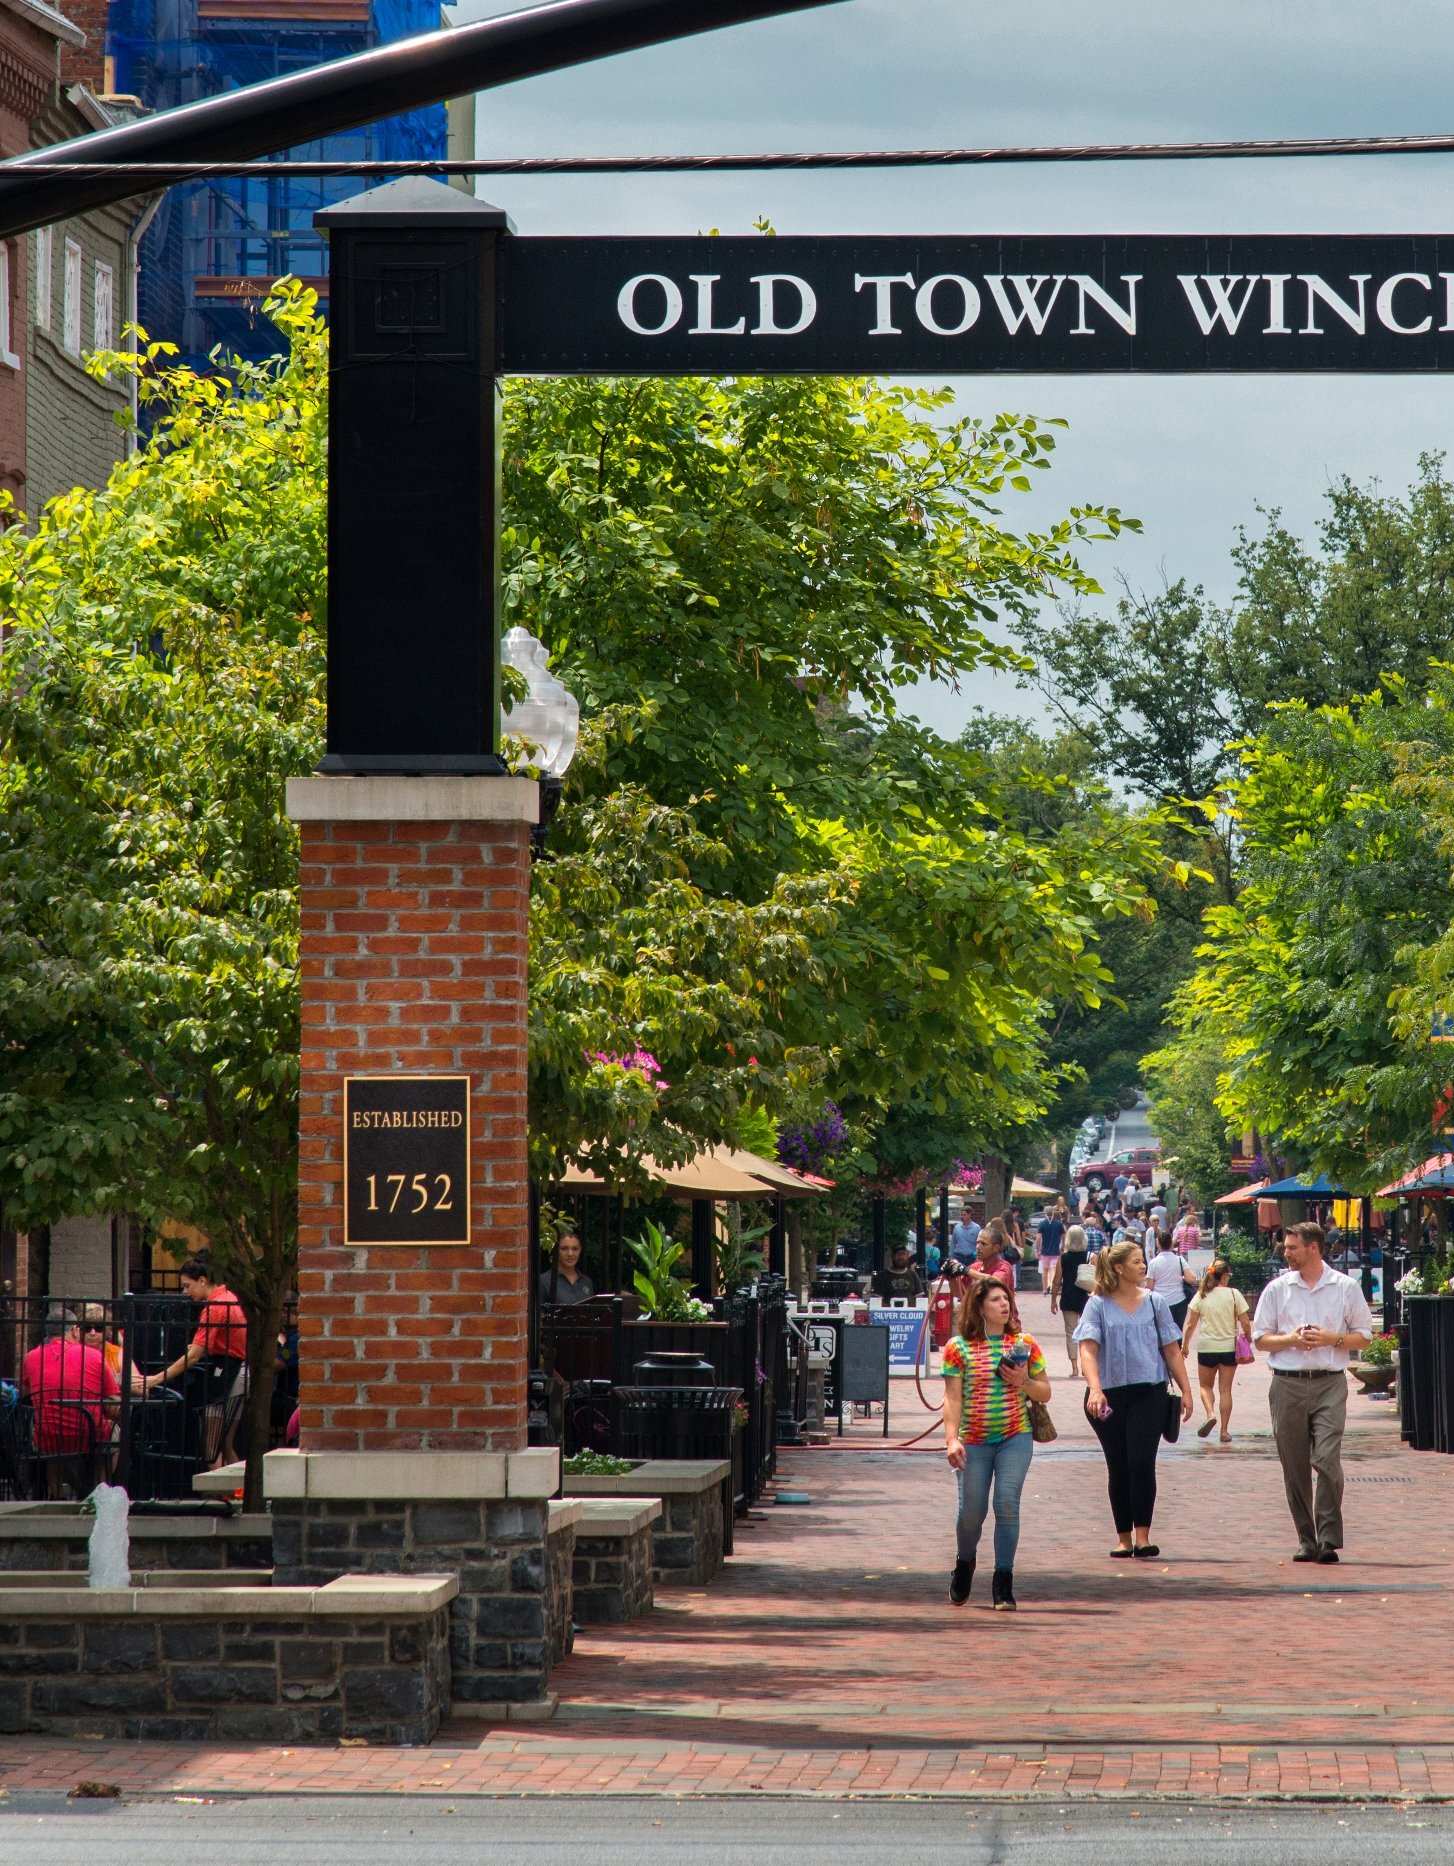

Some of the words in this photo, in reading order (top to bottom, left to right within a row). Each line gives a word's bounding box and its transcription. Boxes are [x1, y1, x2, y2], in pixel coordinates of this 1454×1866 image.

[617, 274, 817, 336] OLD
[854, 271, 1143, 337] TOWN
[352, 1111, 463, 1129] ESTABLISHED
[366, 1173, 453, 1213] 1752
[873, 1312, 898, 1320] SILVER
[899, 1312, 924, 1320] CLOUD
[889, 1324, 915, 1333] WELRY
[889, 1333, 908, 1341] GIFTS
[890, 1342, 905, 1350] ART
